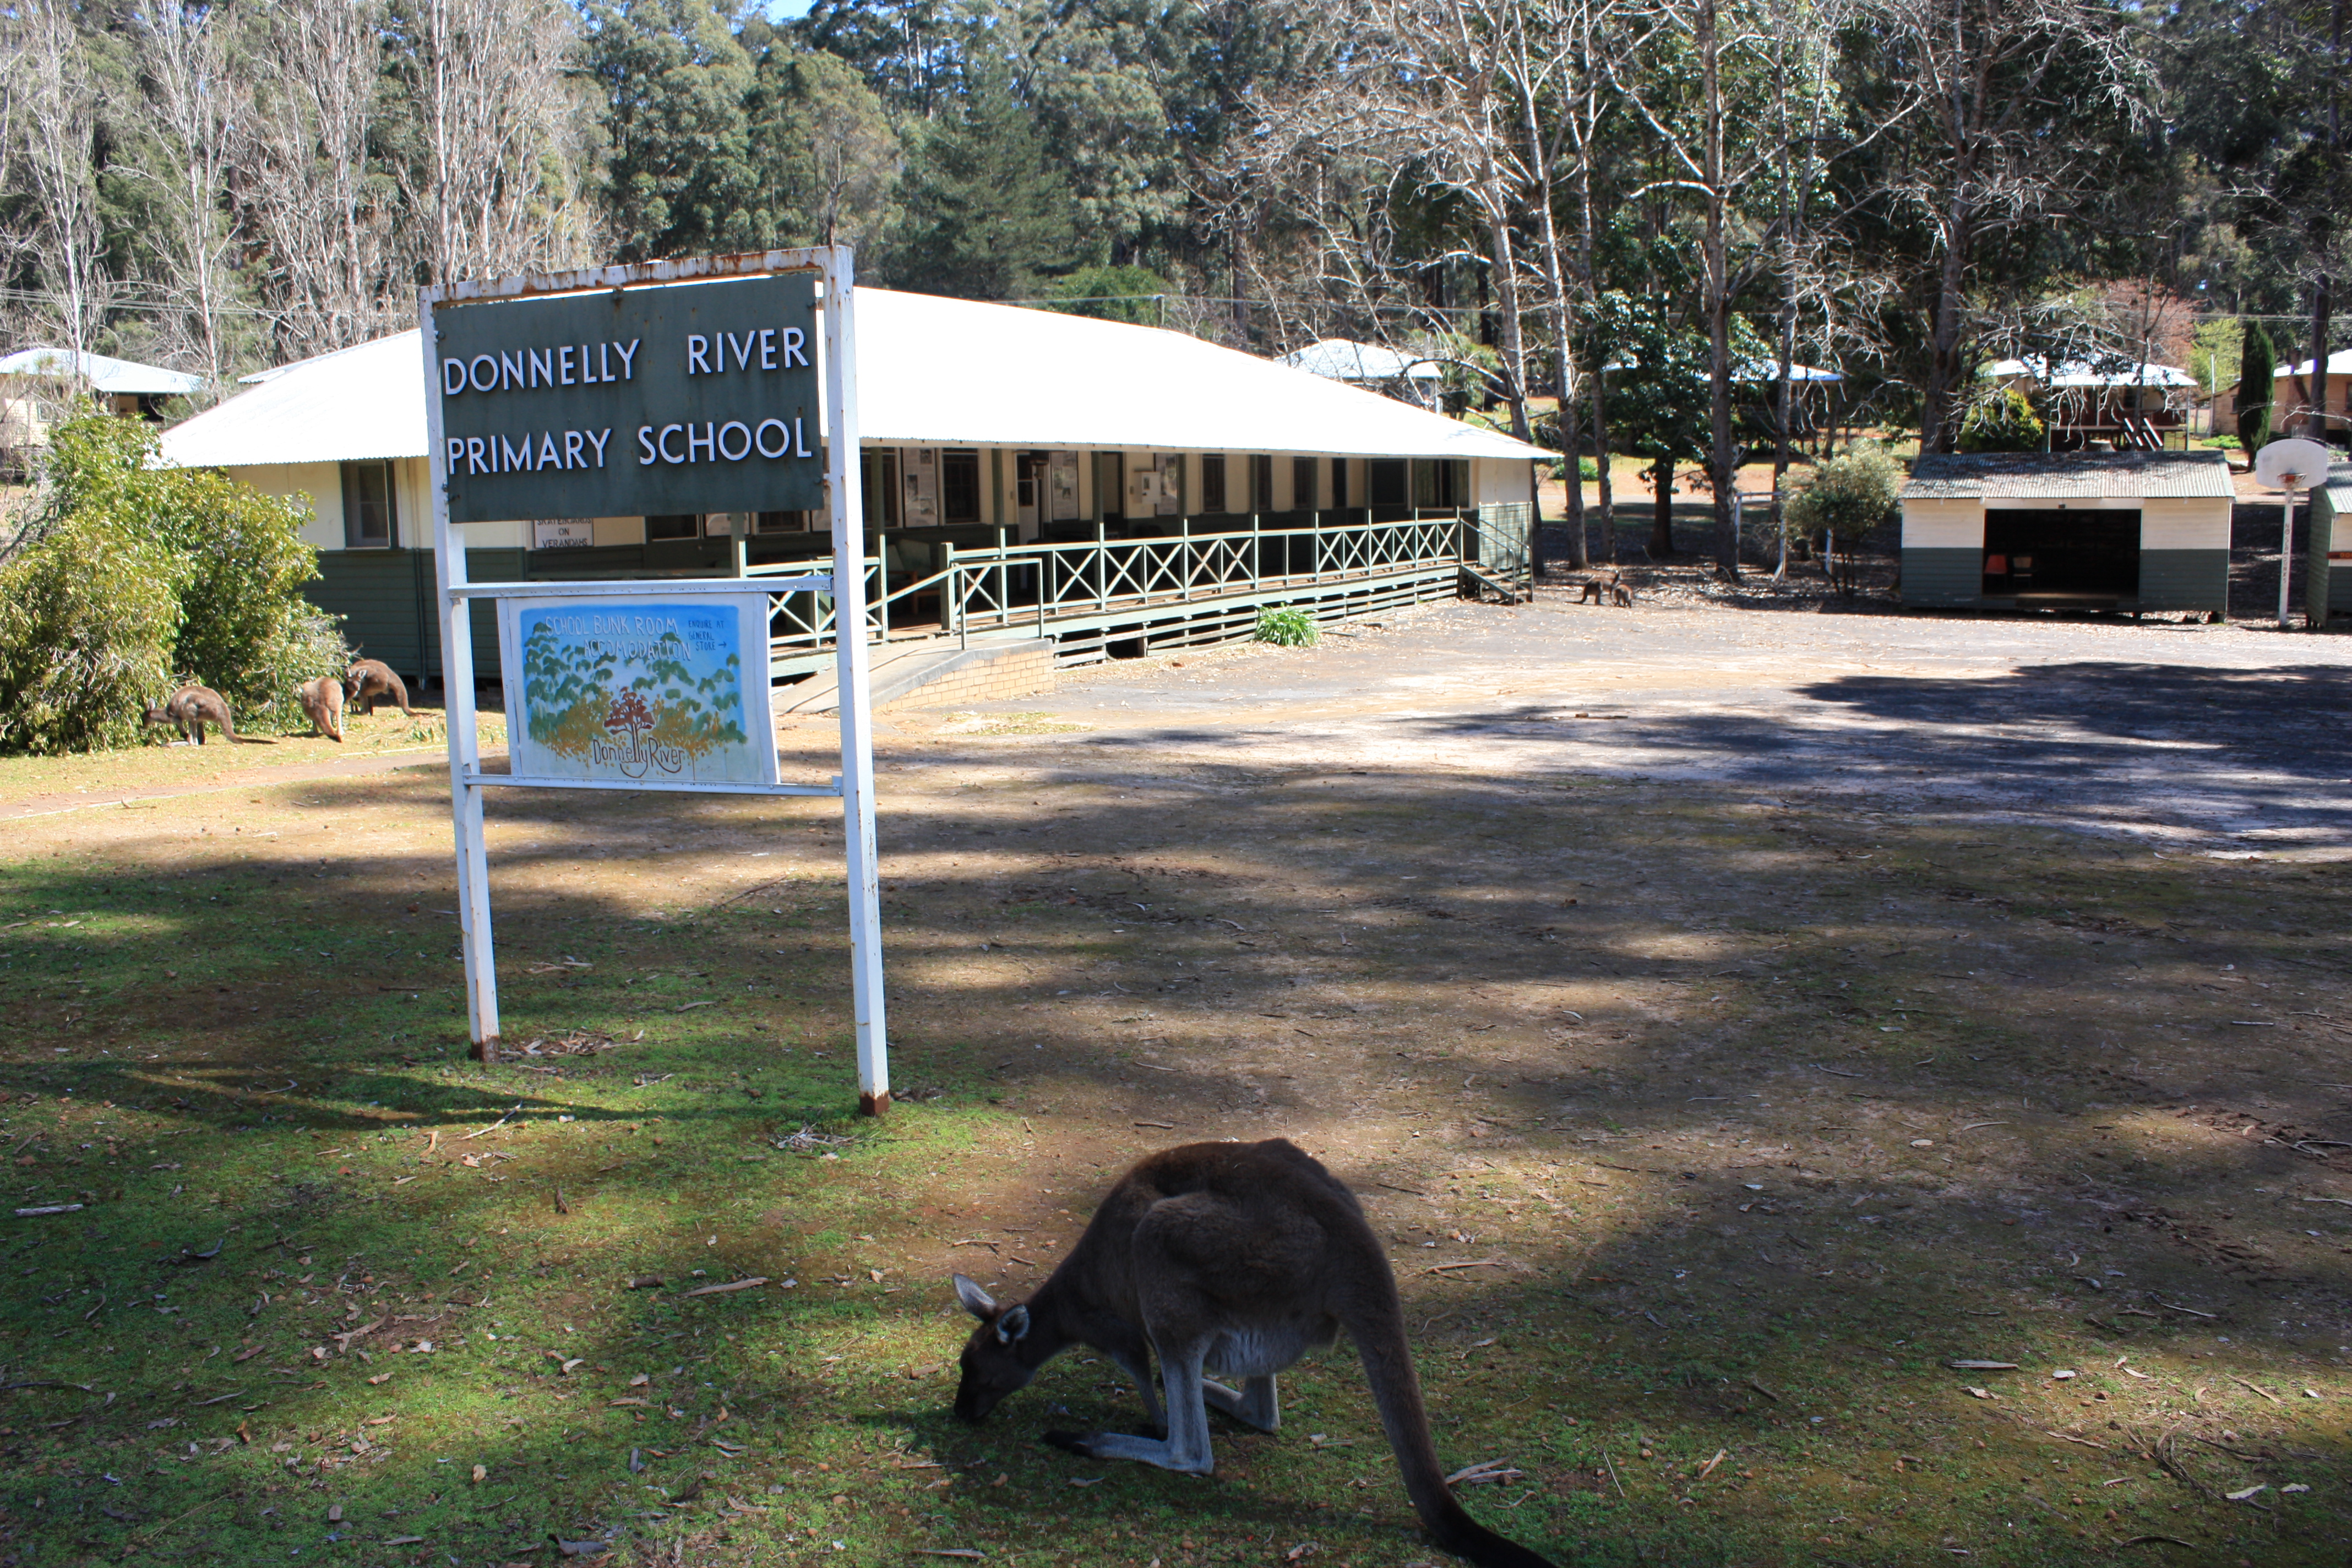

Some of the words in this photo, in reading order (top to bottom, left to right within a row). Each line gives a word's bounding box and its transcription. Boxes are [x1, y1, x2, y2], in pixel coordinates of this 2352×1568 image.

[444, 339, 639, 395] DONNELLY
[688, 327, 809, 374] RIVER
[448, 428, 611, 475] PRIMARY
[639, 418, 812, 464] SCHOOL
[542, 538, 587, 548] VERANDAHS
[546, 616, 592, 636] SCHOOL
[594, 616, 629, 635] BUNK
[635, 618, 679, 636] ROOM
[688, 620, 712, 629] ENQUIRE
[716, 620, 725, 628] AT
[689, 631, 715, 641] GENERAL
[696, 641, 716, 651] STORE
[584, 640, 691, 661] ACCOMODATION
[592, 738, 649, 778] Donnelly
[648, 737, 685, 774] River
